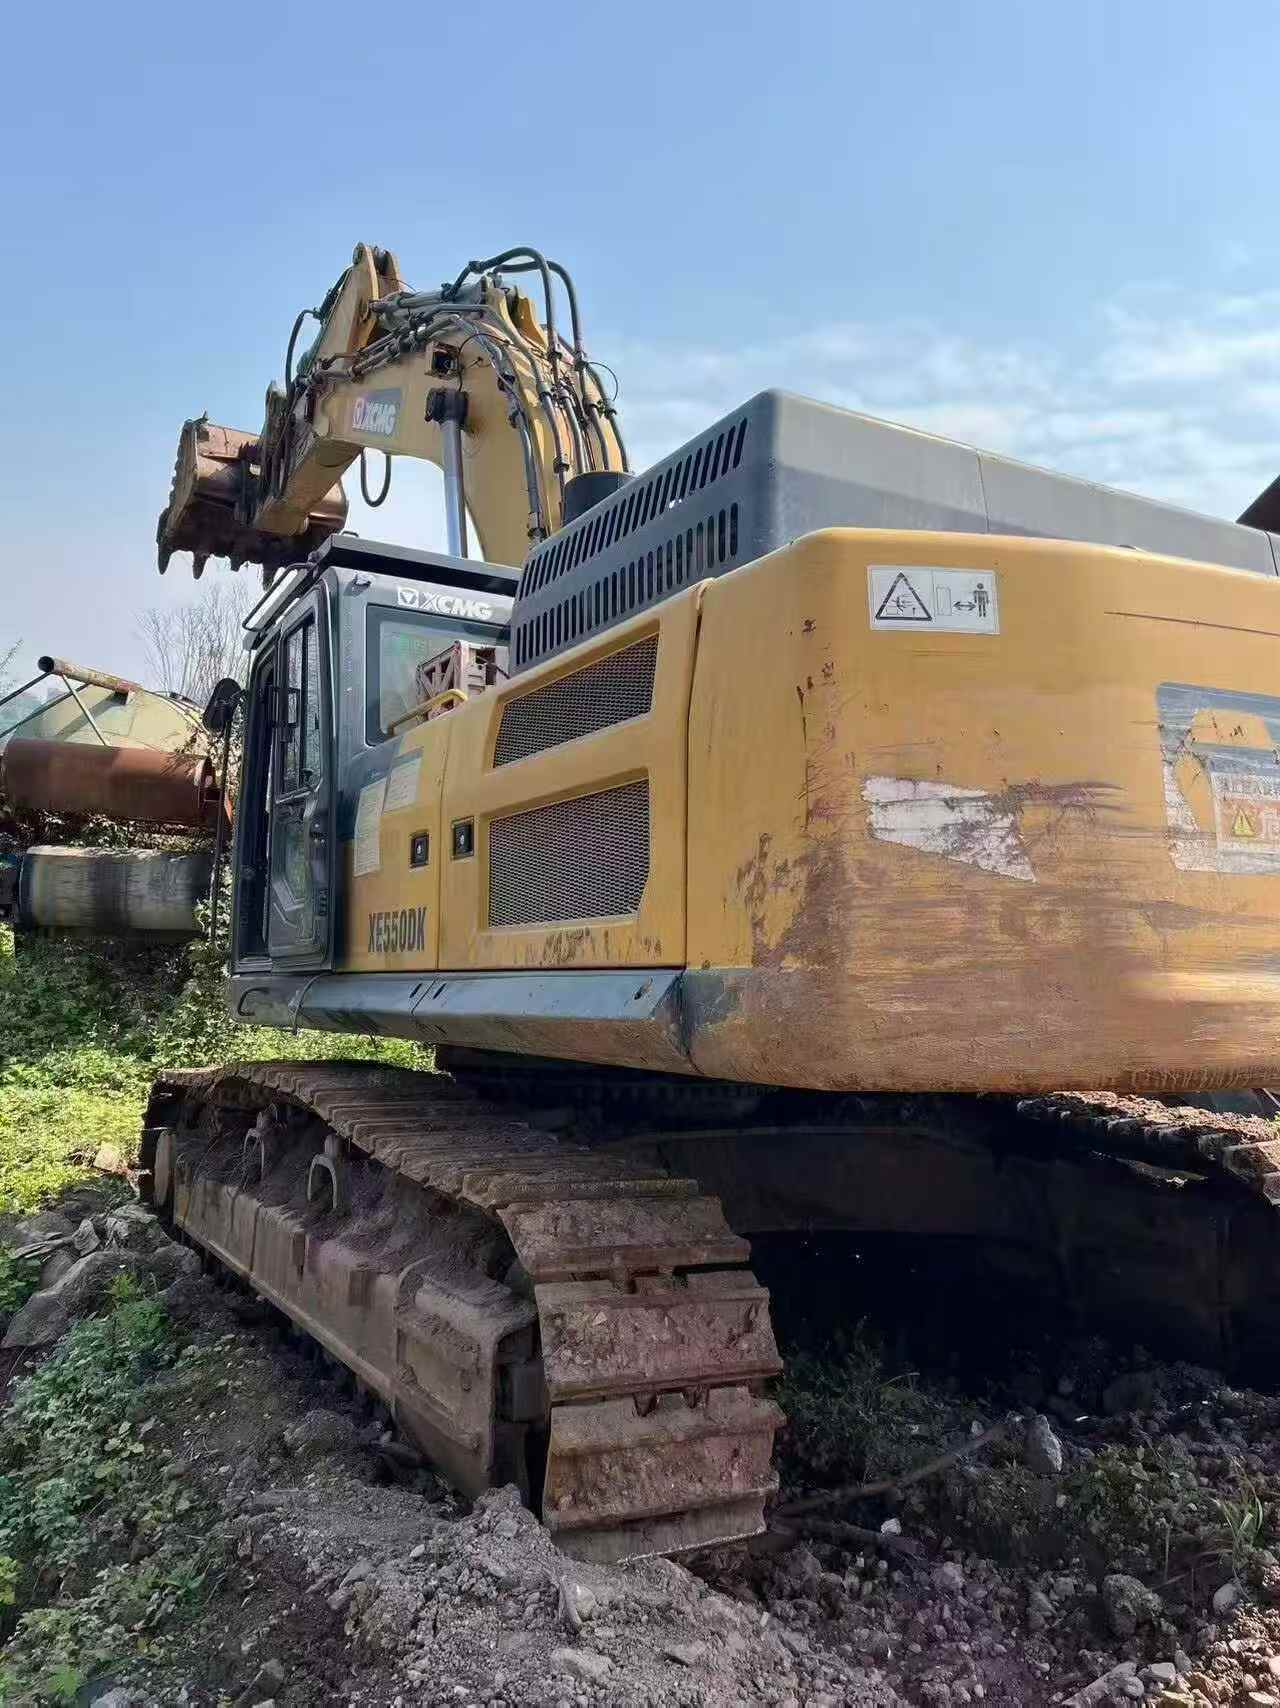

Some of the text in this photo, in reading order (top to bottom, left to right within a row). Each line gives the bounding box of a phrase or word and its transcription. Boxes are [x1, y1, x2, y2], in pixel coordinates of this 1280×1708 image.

[362, 401, 396, 434] XCMG
[420, 591, 493, 620] XCMG
[368, 906, 426, 953] XE550DK
